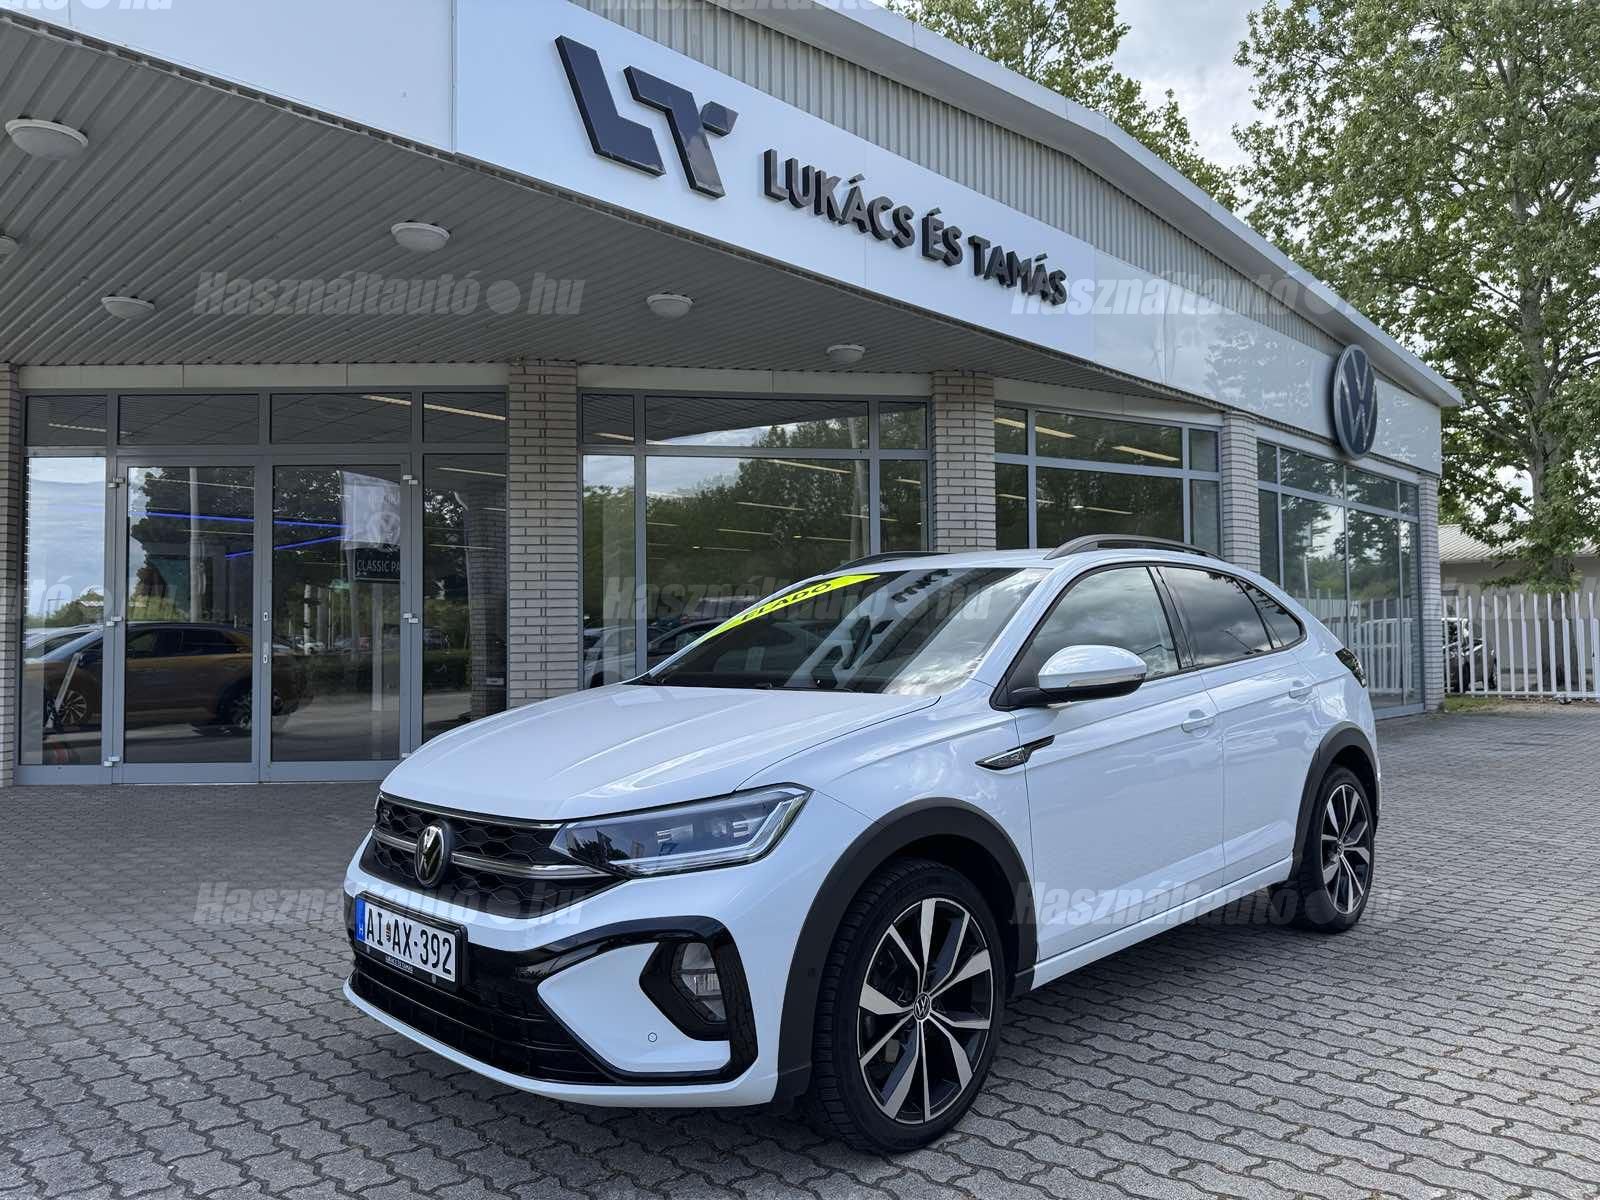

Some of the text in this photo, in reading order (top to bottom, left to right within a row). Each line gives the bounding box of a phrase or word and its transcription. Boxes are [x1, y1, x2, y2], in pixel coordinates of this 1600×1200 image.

[763, 148, 1068, 306] LUKÁCS ÉS TAMÁS
[356, 559, 390, 573] CLASSIC
